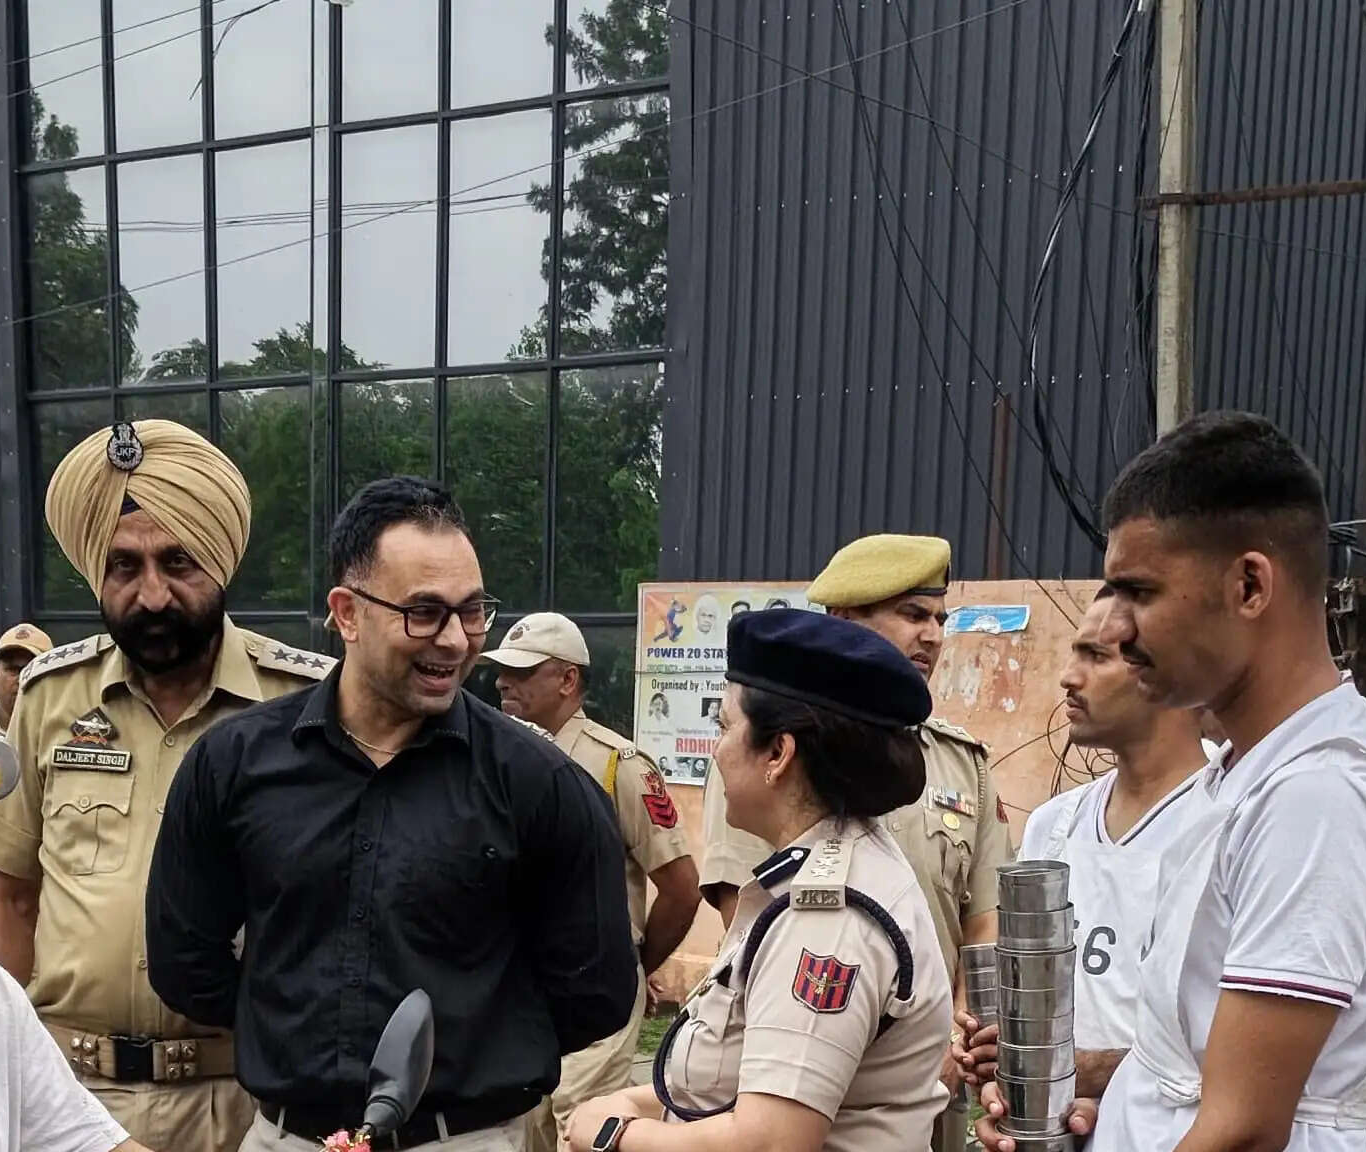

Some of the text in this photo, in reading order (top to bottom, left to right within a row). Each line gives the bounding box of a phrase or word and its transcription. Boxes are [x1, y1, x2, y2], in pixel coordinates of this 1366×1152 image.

[117, 447, 135, 457] JKP
[647, 648, 728, 659] POWER 20 STA
[651, 679, 688, 691] Organised
[689, 679, 699, 692] by
[56, 751, 125, 767] DALJEET SINGH
[1074, 919, 1117, 976] 6
